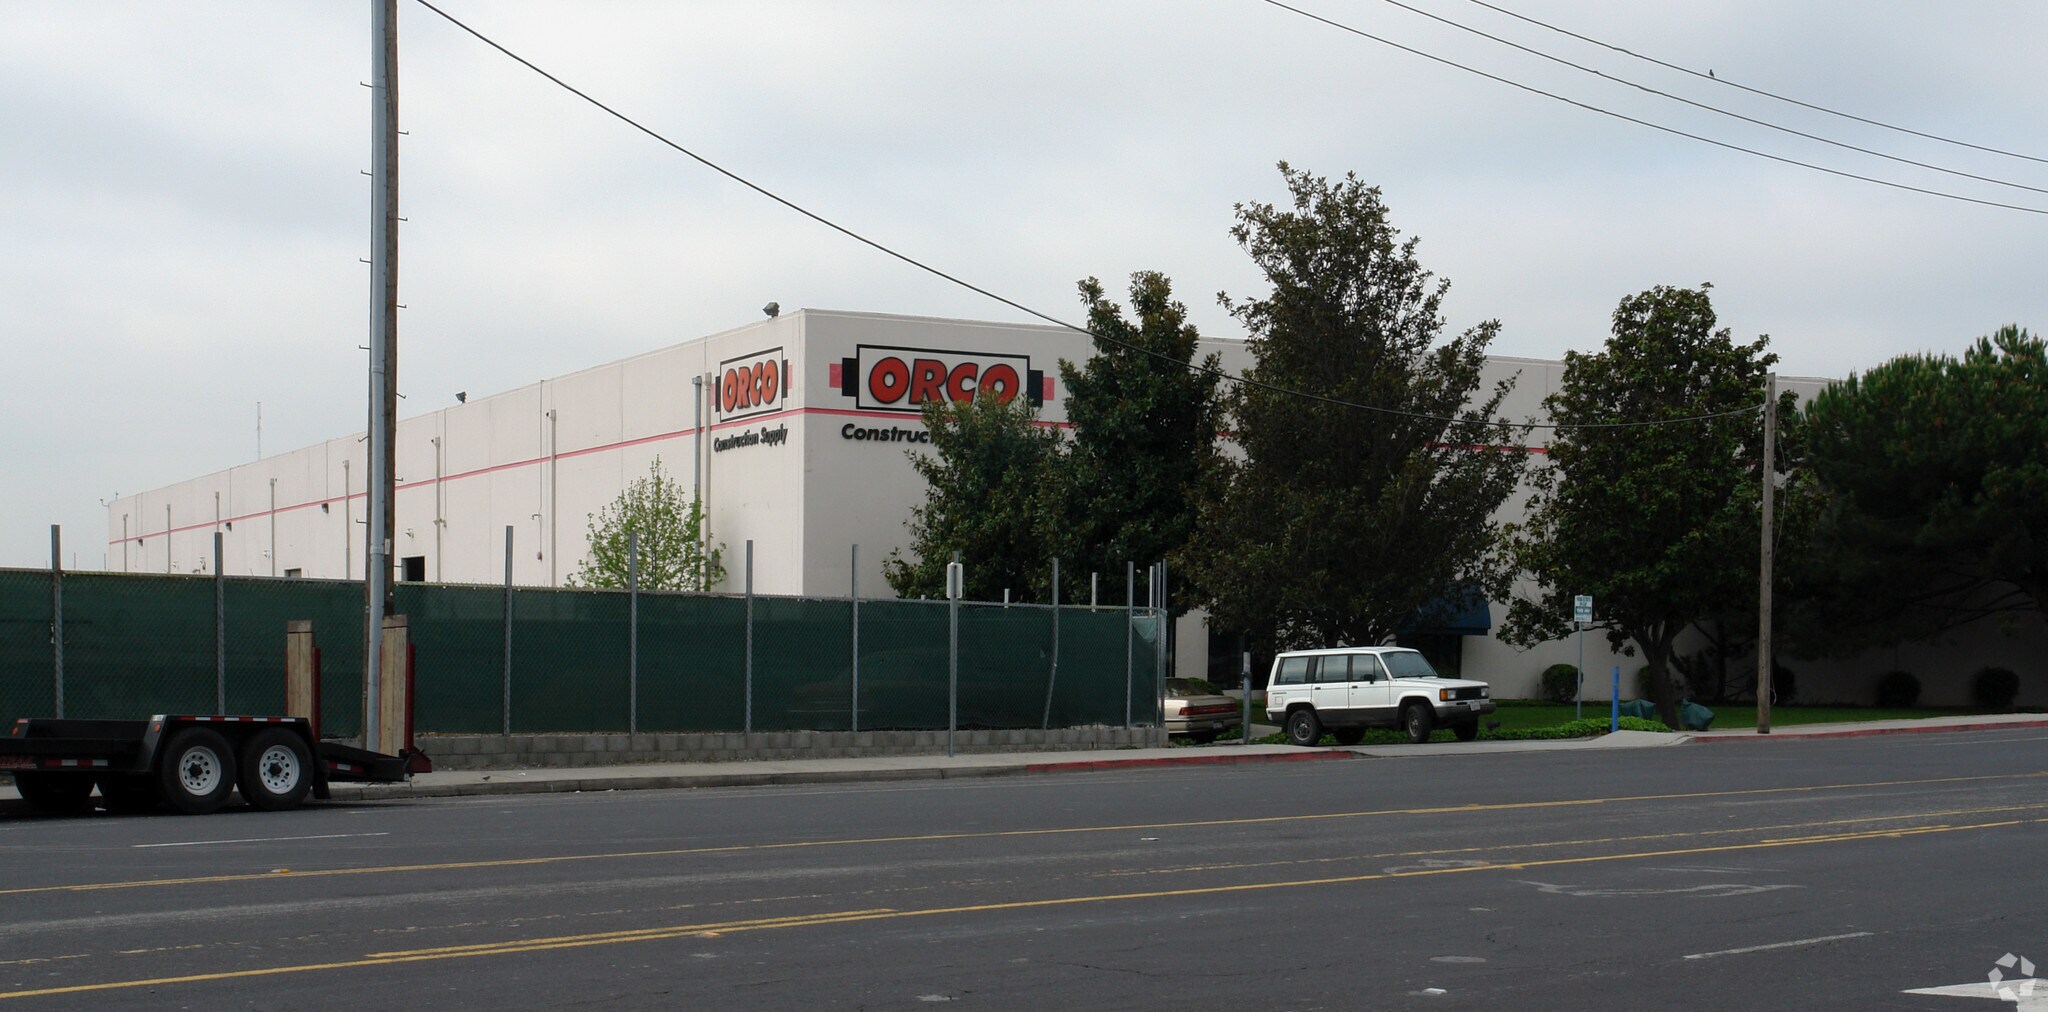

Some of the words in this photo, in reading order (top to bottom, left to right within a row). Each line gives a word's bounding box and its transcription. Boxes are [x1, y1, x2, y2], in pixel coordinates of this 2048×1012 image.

[723, 359, 779, 413] ORCO
[869, 356, 1020, 407] ORCO
[714, 429, 759, 453] Construction
[760, 423, 788, 447] Supply
